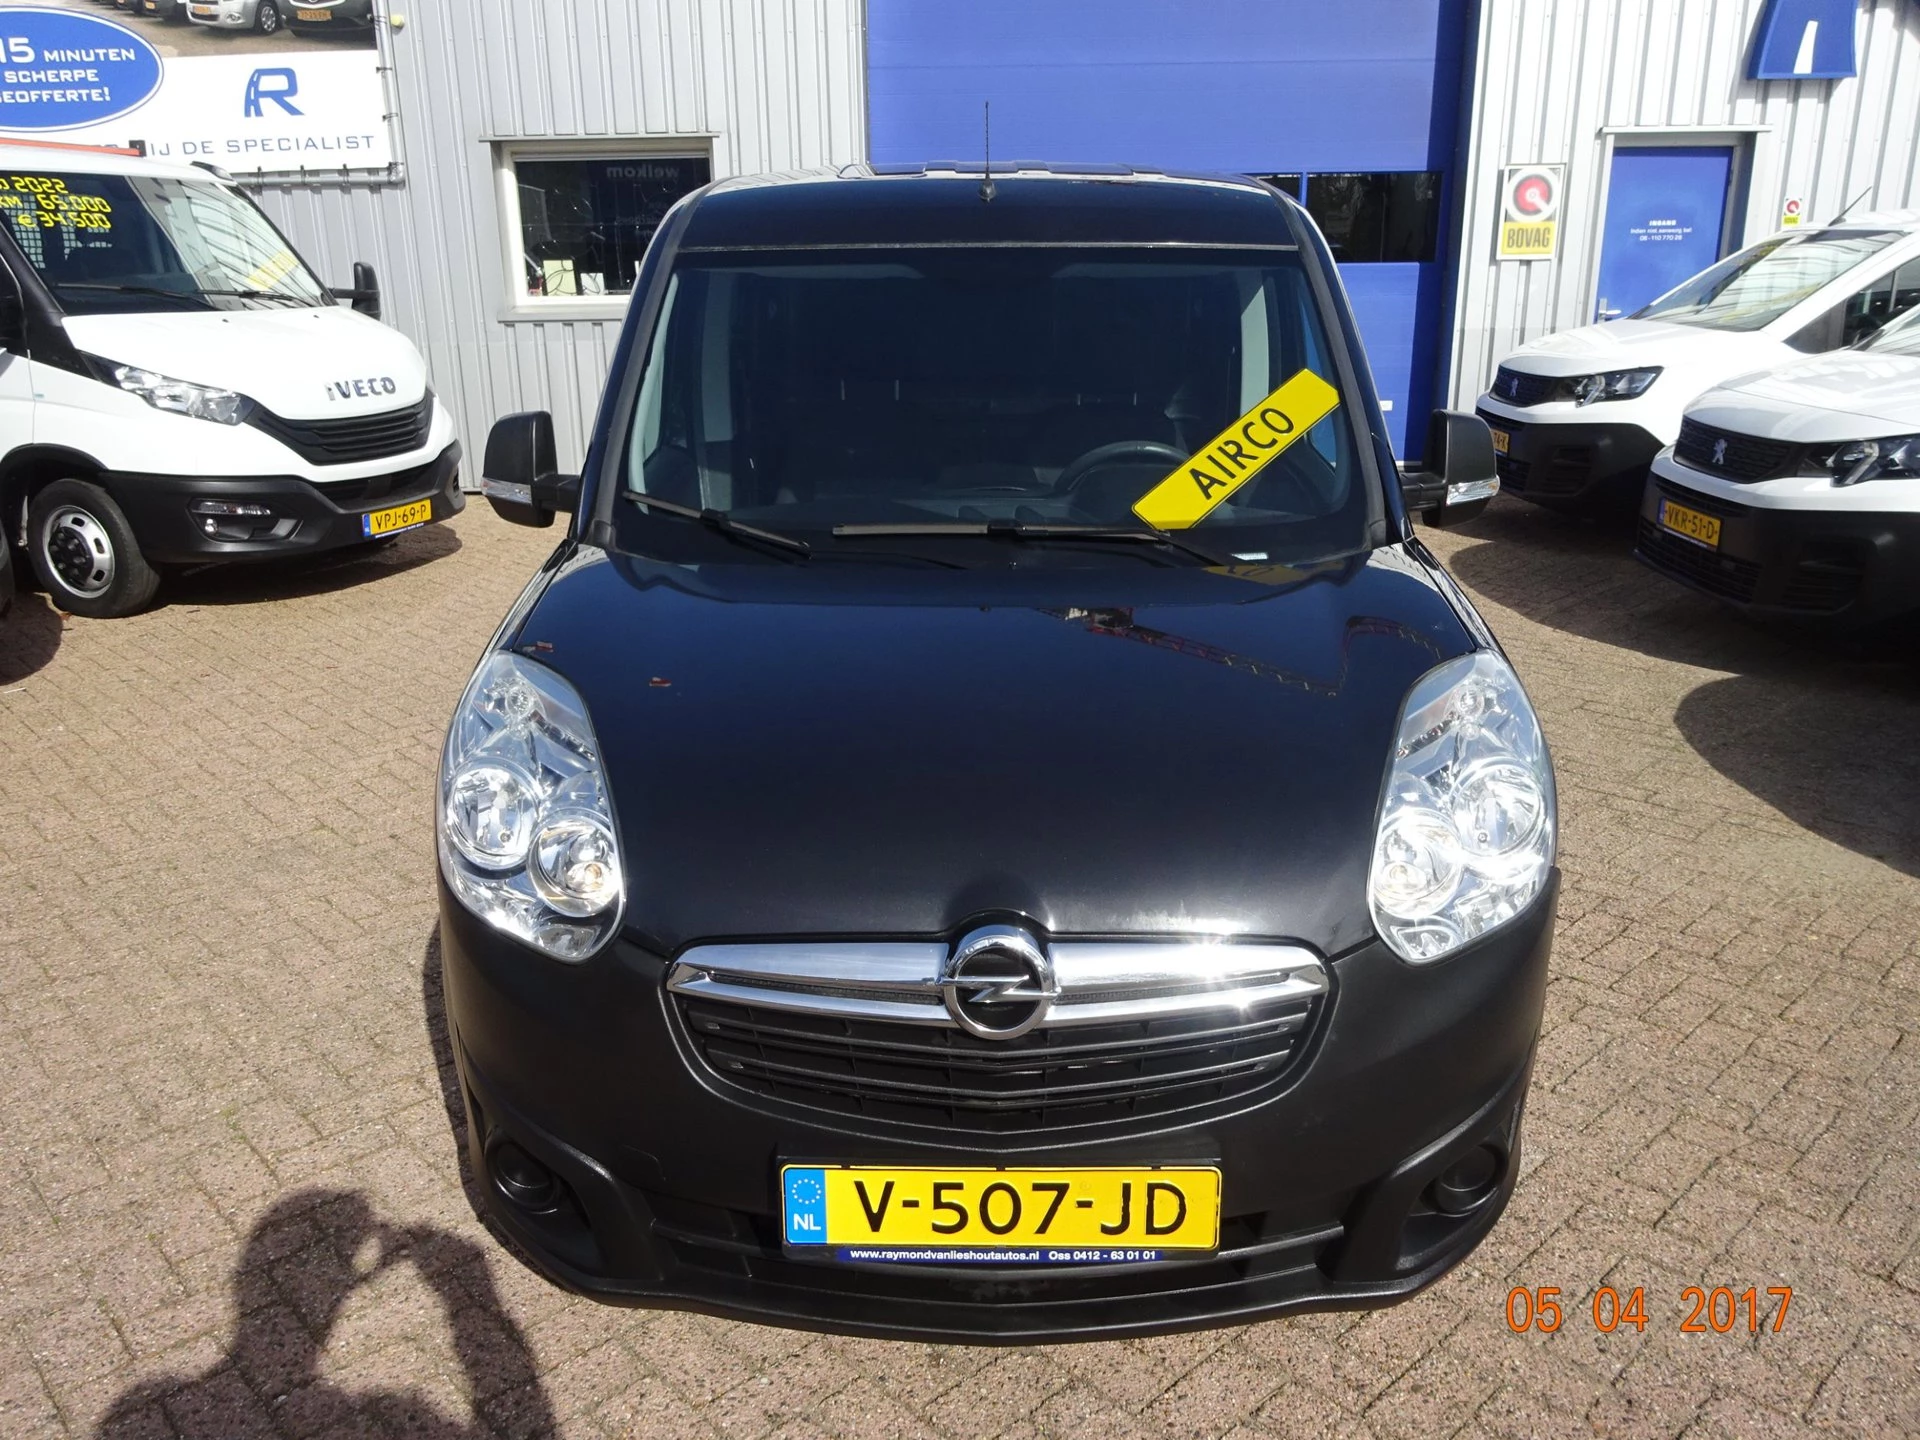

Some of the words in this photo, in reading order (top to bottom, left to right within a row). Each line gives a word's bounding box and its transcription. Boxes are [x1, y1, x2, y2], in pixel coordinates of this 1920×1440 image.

[44, 48, 135, 63] MINUTEN
[4, 68, 99, 83] SCHERPE
[183, 140, 214, 155] DE
[226, 135, 374, 153] SPECIALIST
[11, 176, 69, 194] 2022
[1506, 227, 1551, 249] BOVAG
[1188, 407, 1295, 500] AIRCO
[375, 503, 427, 530] VPJ-69-P
[1667, 504, 1715, 540] VKR-51-D
[853, 1180, 1187, 1235] V-507-JD
[793, 1213, 821, 1231] NL
[850, 1249, 1040, 1261] www.raymondvanlieshoutautos.nl
[1048, 1250, 1071, 1260] Oss
[1073, 1250, 1101, 1260] 0412
[1110, 1250, 1125, 1260] 63
[1126, 1250, 1140, 1260] 01
[1142, 1250, 1156, 1260] 01
